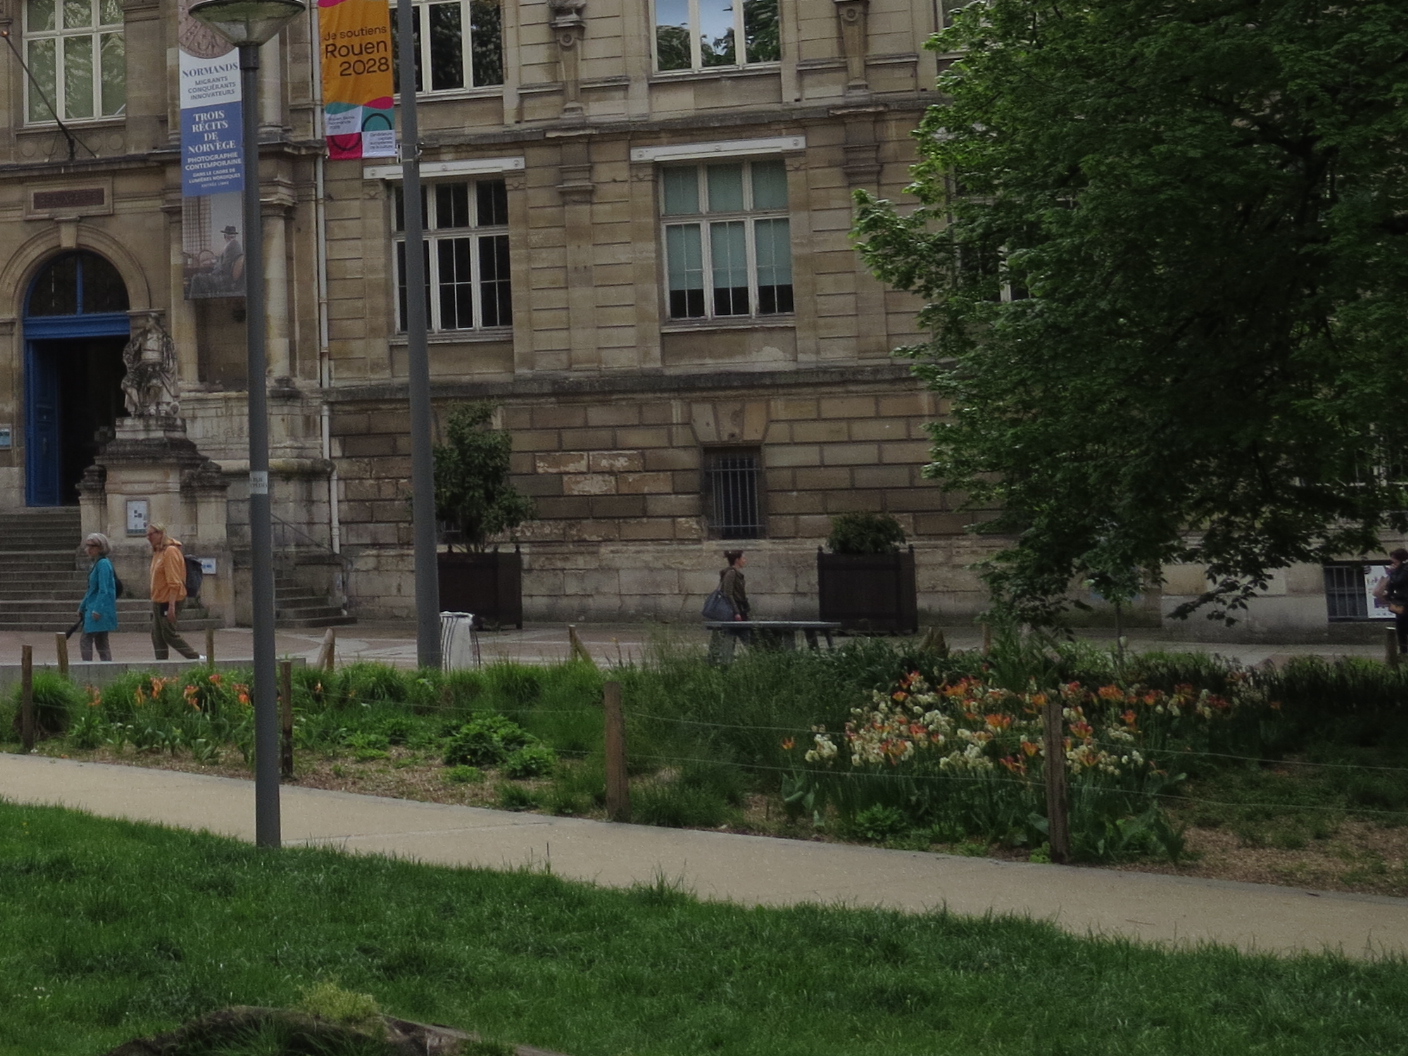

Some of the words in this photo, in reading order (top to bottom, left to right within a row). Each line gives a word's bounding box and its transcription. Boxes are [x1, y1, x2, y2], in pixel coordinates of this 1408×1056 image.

[324, 32, 337, 41] Je
[340, 25, 387, 39] soutiens
[325, 40, 388, 60] Rouen
[182, 61, 239, 78] NORMANDS
[339, 56, 390, 77] 2028
[194, 75, 228, 86] MIGRANTS
[190, 88, 235, 100] INNOVATEURS
[192, 110, 225, 122] TROIS
[192, 120, 229, 133] RÉCITS
[204, 132, 219, 142] DE
[188, 140, 236, 154] NORVÈGE
[187, 151, 239, 164] PHOTOGRAPHIE
[185, 158, 242, 171] CONTEMPORAINE
